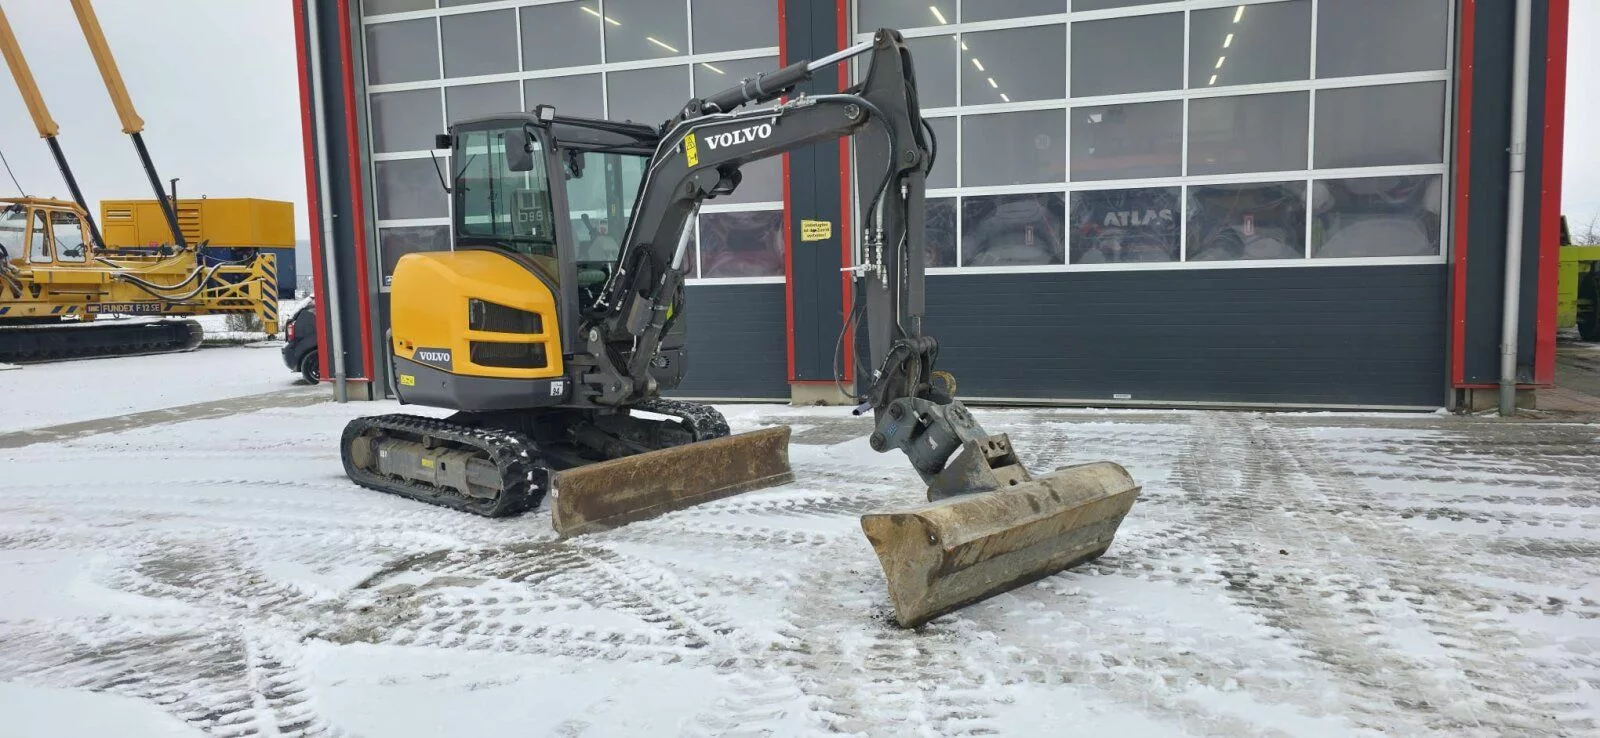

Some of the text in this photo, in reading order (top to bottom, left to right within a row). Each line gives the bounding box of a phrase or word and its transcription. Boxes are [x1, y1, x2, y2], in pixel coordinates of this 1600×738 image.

[704, 123, 772, 150] VOLVO
[103, 304, 134, 312] FUNDEX
[136, 304, 141, 312] F
[142, 304, 151, 312] 12
[151, 303, 160, 312] SE
[419, 351, 451, 362] VOLVO
